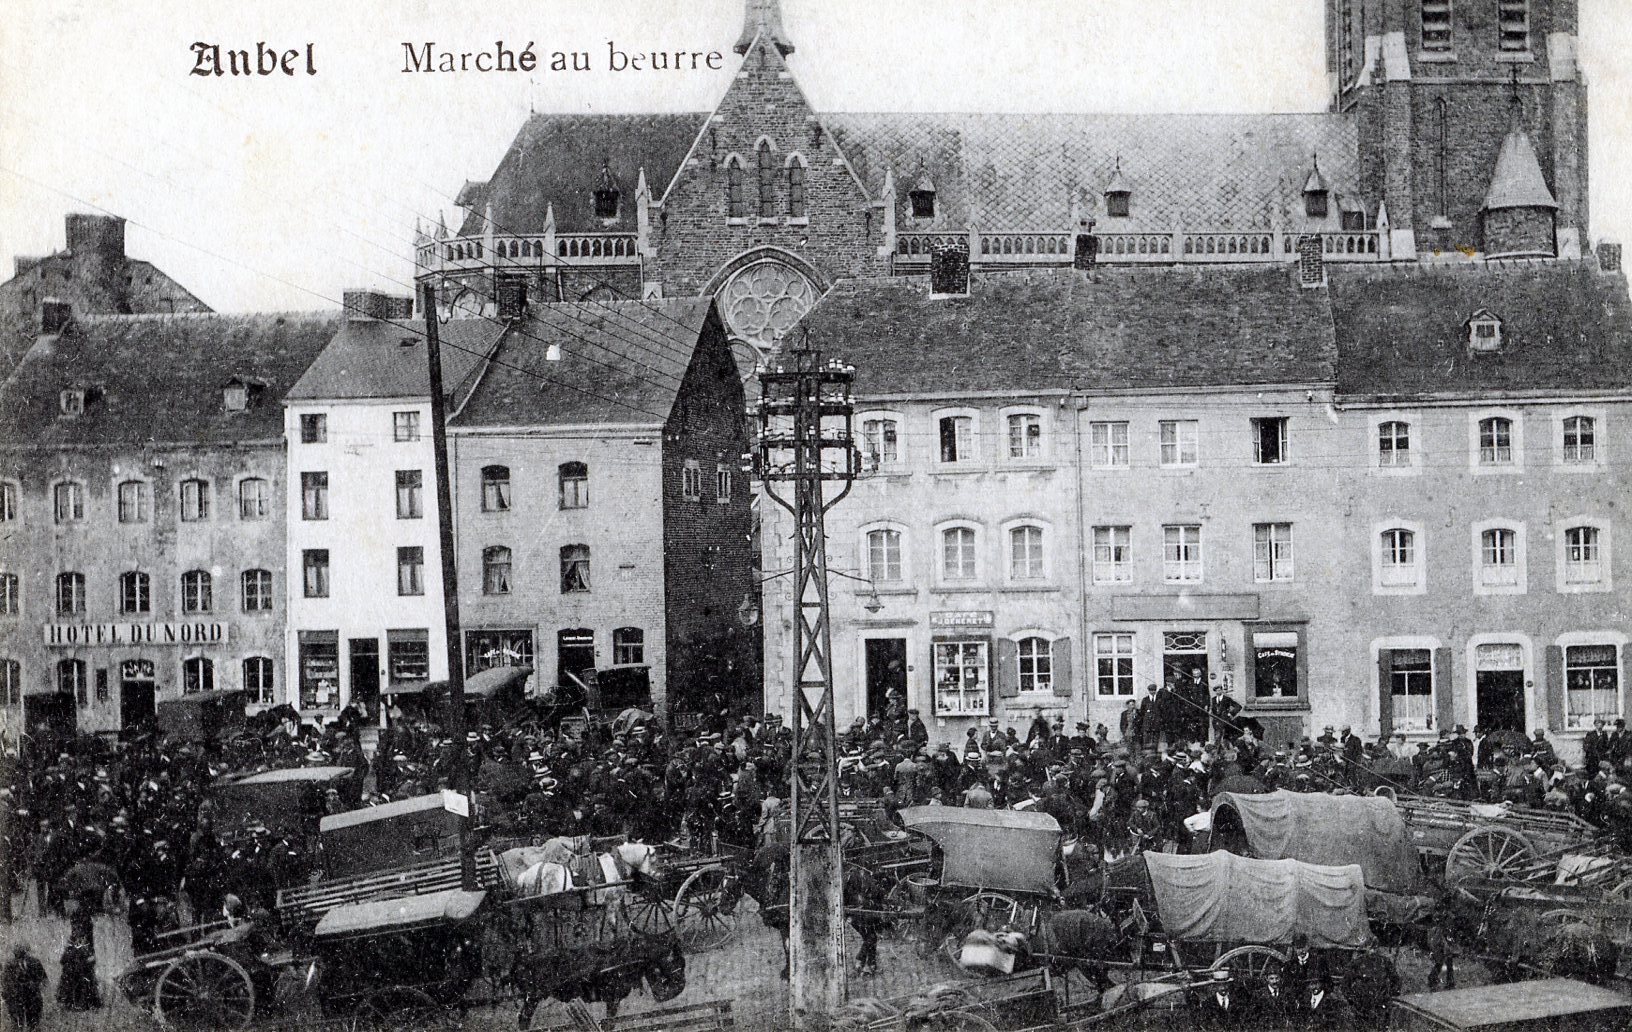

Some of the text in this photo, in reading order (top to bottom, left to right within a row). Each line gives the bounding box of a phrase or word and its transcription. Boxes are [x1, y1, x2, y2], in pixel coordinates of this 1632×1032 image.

[50, 623, 222, 644] HOTEL DU NORD
